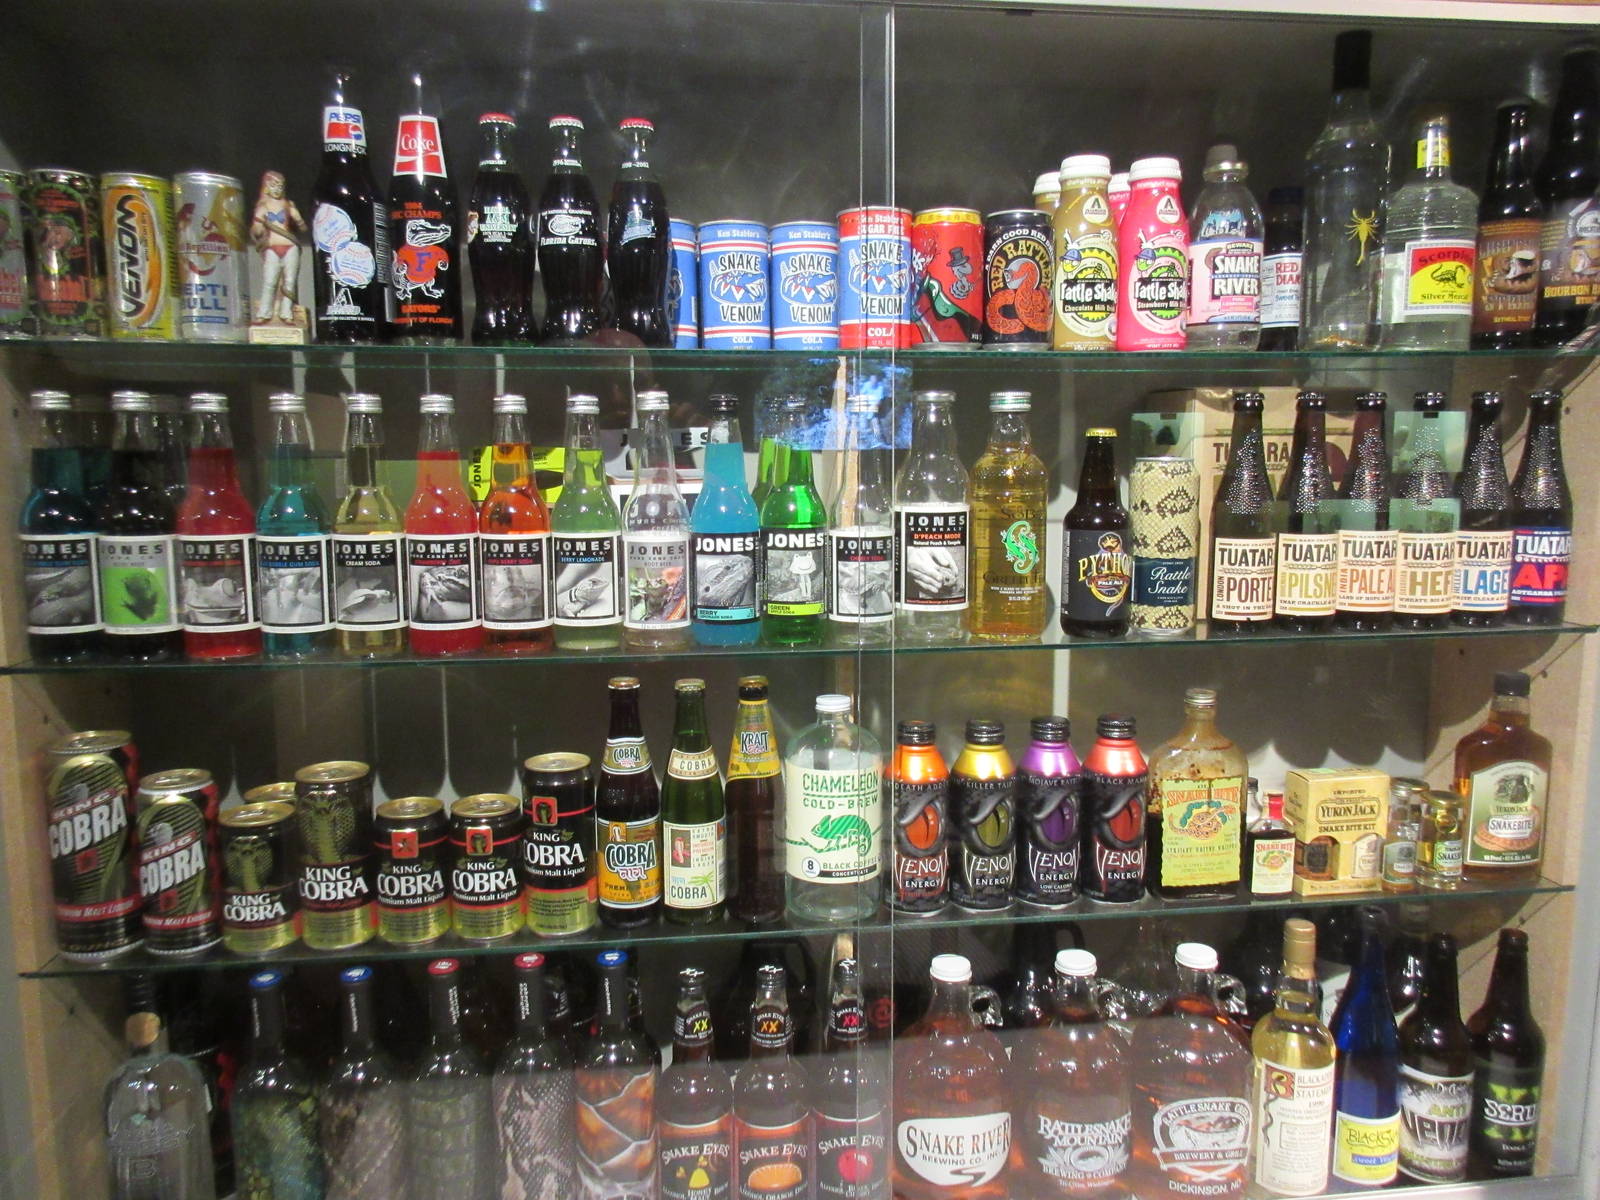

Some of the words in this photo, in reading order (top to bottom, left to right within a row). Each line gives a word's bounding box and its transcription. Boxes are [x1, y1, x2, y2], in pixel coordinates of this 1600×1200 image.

[328, 112, 362, 124] PEPSI
[324, 144, 366, 156] LONGNECK
[400, 134, 434, 152] Coke
[716, 230, 732, 238] Ken
[1002, 228, 1030, 240] GOOD
[1030, 228, 1046, 242] RED
[116, 194, 146, 318] VENOM
[860, 242, 904, 262] SNAKE
[416, 252, 432, 272] F
[718, 252, 760, 272] SNAKE
[790, 254, 832, 274] SNAKE
[990, 256, 1006, 292] RED
[1002, 240, 1052, 288] RATTLER
[1214, 256, 1260, 274] SNAKE
[1274, 262, 1298, 274] RED
[1214, 278, 1258, 296] RIVER
[860, 296, 904, 316] VENOM
[1064, 304, 1094, 312] Chocolate
[1094, 304, 1106, 312] Milk
[1136, 300, 1168, 310] Strawberry
[720, 304, 762, 324] VENOM
[790, 304, 834, 324] VENOM
[732, 336, 754, 344] COLA
[802, 336, 824, 344] COLA
[866, 328, 896, 336] COLA
[908, 514, 966, 526] JONES
[696, 536, 754, 552] JONES
[766, 532, 826, 548] JONES
[838, 538, 892, 550] JONES
[914, 532, 942, 540] D'PEACH
[944, 532, 962, 540] MODE
[1516, 534, 1572, 554] TUATAR
[336, 542, 394, 554] JONES
[410, 542, 468, 554] JONES
[484, 542, 540, 554] JONES
[556, 540, 612, 552] JONES
[630, 544, 684, 556] JONES
[1282, 542, 1338, 562] TUATAR
[1342, 540, 1398, 558] TUATAR
[1402, 542, 1456, 562] TUATAR
[1456, 540, 1512, 560] TUATAR
[576, 556, 606, 564] LEMONADE
[1218, 548, 1274, 568] TUATAR
[1150, 566, 1190, 582] Rattle
[1338, 568, 1348, 592] INDIA
[1350, 568, 1386, 594] PALE
[1462, 568, 1510, 596] LAGE
[1148, 580, 1188, 594] Snake
[1216, 576, 1224, 602] LONDON
[1226, 576, 1274, 604] PORTE
[770, 604, 790, 612] GREEN
[740, 730, 768, 754] KRAIT
[612, 746, 642, 764] COBRA
[680, 758, 712, 772] COBRA
[802, 772, 878, 794] CHAMELEON
[966, 780, 996, 790] KILLER
[1096, 776, 1124, 786] BLACK
[1320, 804, 1352, 818] YUKON
[1354, 804, 1376, 816] JACK
[48, 794, 128, 860] COBRA
[1318, 824, 1344, 834] SNAKE
[1346, 824, 1362, 832] BITE
[1362, 822, 1376, 830] KIT
[1488, 818, 1534, 832] SNAKEBITE
[532, 830, 560, 842] KING
[522, 840, 586, 866] COBRA
[604, 840, 658, 872] COBRA
[140, 840, 206, 896] COBRA
[392, 864, 422, 874] KING
[466, 860, 494, 870] KING
[544, 868, 562, 876] Malt
[562, 866, 586, 876] Liquor
[806, 860, 814, 870] 8
[822, 860, 852, 870] BLACK
[304, 866, 352, 882] KING
[452, 868, 518, 894] COBRA
[974, 876, 1010, 886] ENERGY
[1040, 872, 1074, 882] ENERGY
[1106, 870, 1140, 880] ENERGY
[298, 876, 370, 902] COBRA
[376, 870, 444, 898] COBRA
[904, 878, 942, 888] ENERGY
[232, 892, 270, 906] KING
[406, 896, 422, 904] Malt
[422, 890, 446, 904] Liquor
[478, 892, 496, 902] Malt
[496, 888, 518, 900] Liquor
[670, 886, 708, 900] COBRA
[224, 902, 286, 924] COBRA
[692, 1018, 708, 1034] XX
[760, 1020, 778, 1032] XX
[842, 1014, 860, 1028] XX
[1296, 1074, 1322, 1086] BLACK
[1162, 1102, 1232, 1128] RATTLESNAKE
[1484, 1096, 1538, 1122] SERU
[1038, 1112, 1132, 1140] RATTLESNAKE
[818, 1136, 856, 1156] SNAKE
[860, 1134, 886, 1148] EYES
[906, 1124, 964, 1158] SNAKE
[972, 1116, 1010, 1158] RIVER
[1054, 1132, 1124, 1148] MOUNTAIN
[662, 1144, 700, 1166] SNAKE
[702, 1142, 730, 1158] EYES
[740, 1144, 780, 1164] SNAKE
[782, 1142, 808, 1158] EYES
[922, 1154, 966, 1168] BREWING
[968, 1156, 982, 1166] CO.
[1174, 1152, 1214, 1162] BREWERY
[1224, 1150, 1244, 1158] GRILL
[1042, 1164, 1084, 1180] BREWING
[1230, 1180, 1242, 1192] ND
